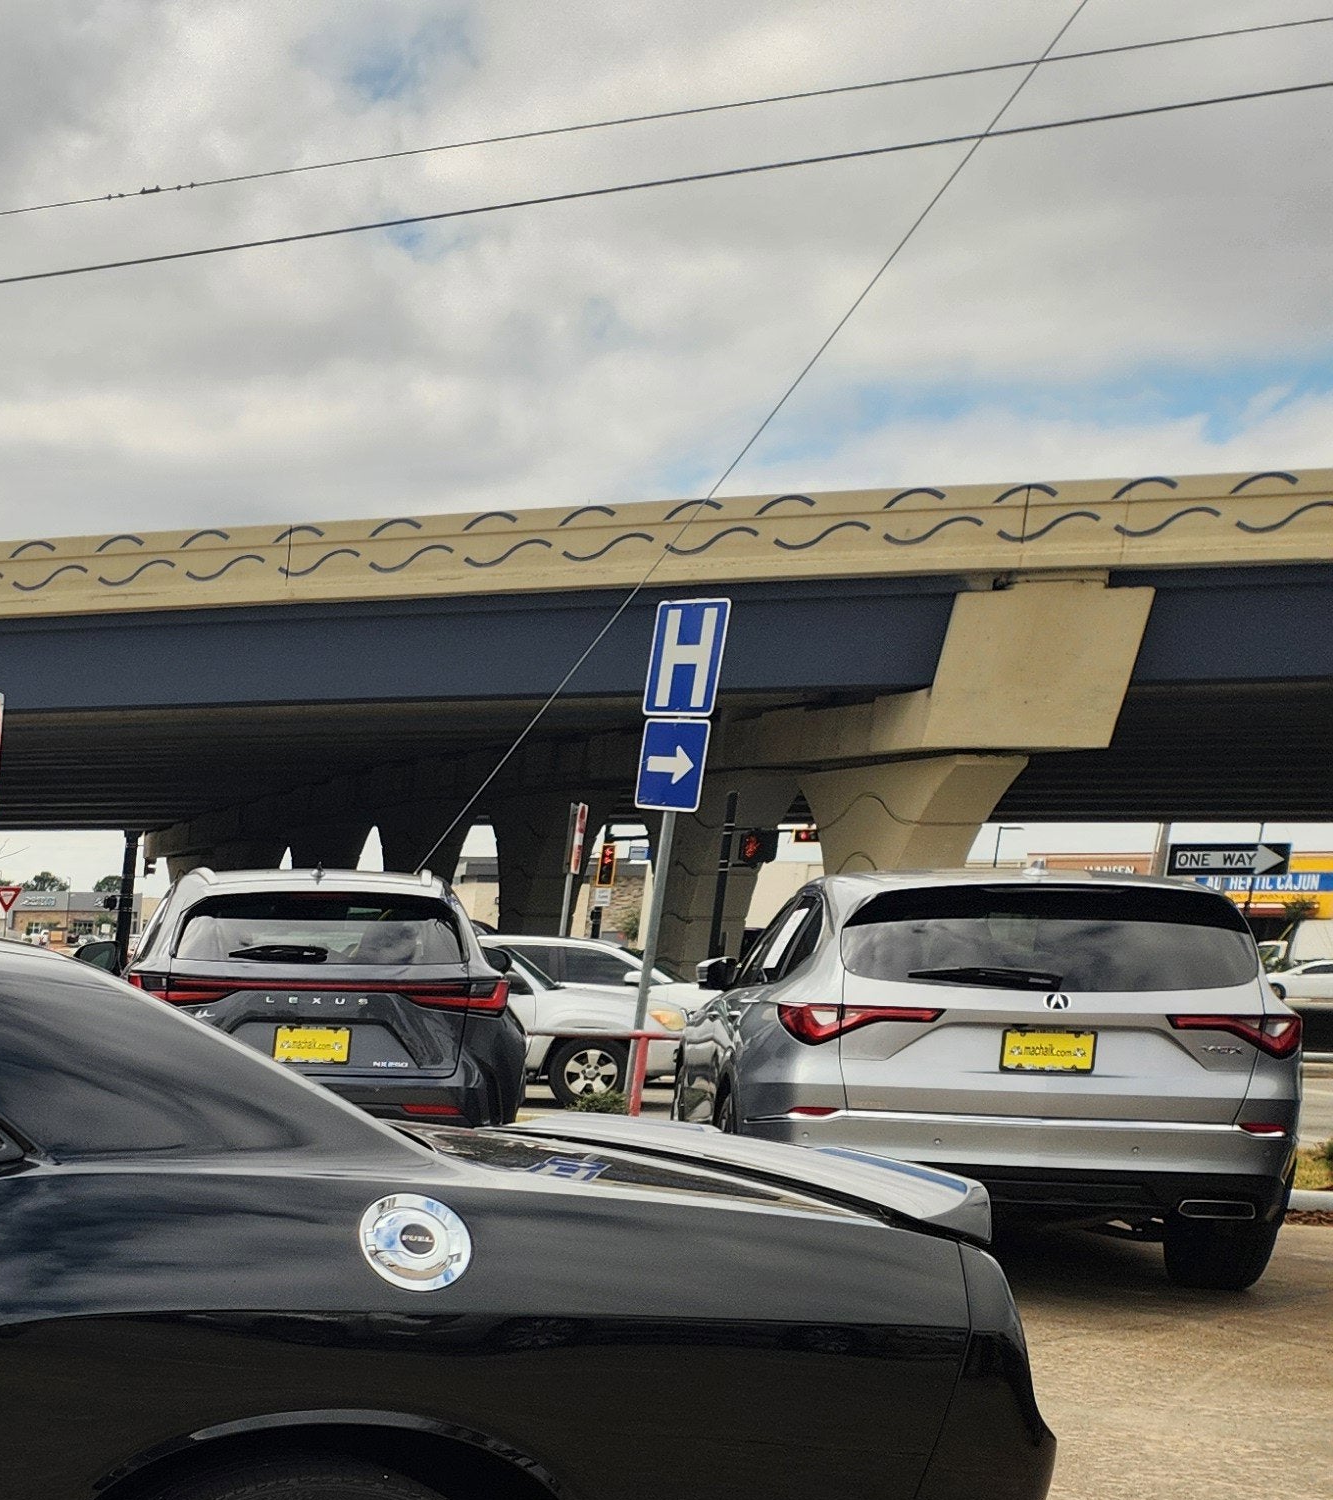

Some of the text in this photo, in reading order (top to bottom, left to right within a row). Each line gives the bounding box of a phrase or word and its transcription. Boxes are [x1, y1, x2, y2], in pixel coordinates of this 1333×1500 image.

[654, 608, 718, 708] H
[1177, 852, 1257, 867] ONE WAY
[1276, 874, 1321, 891] CAJUN
[265, 996, 369, 1006] LEXUS
[401, 1234, 434, 1244] FUEL
